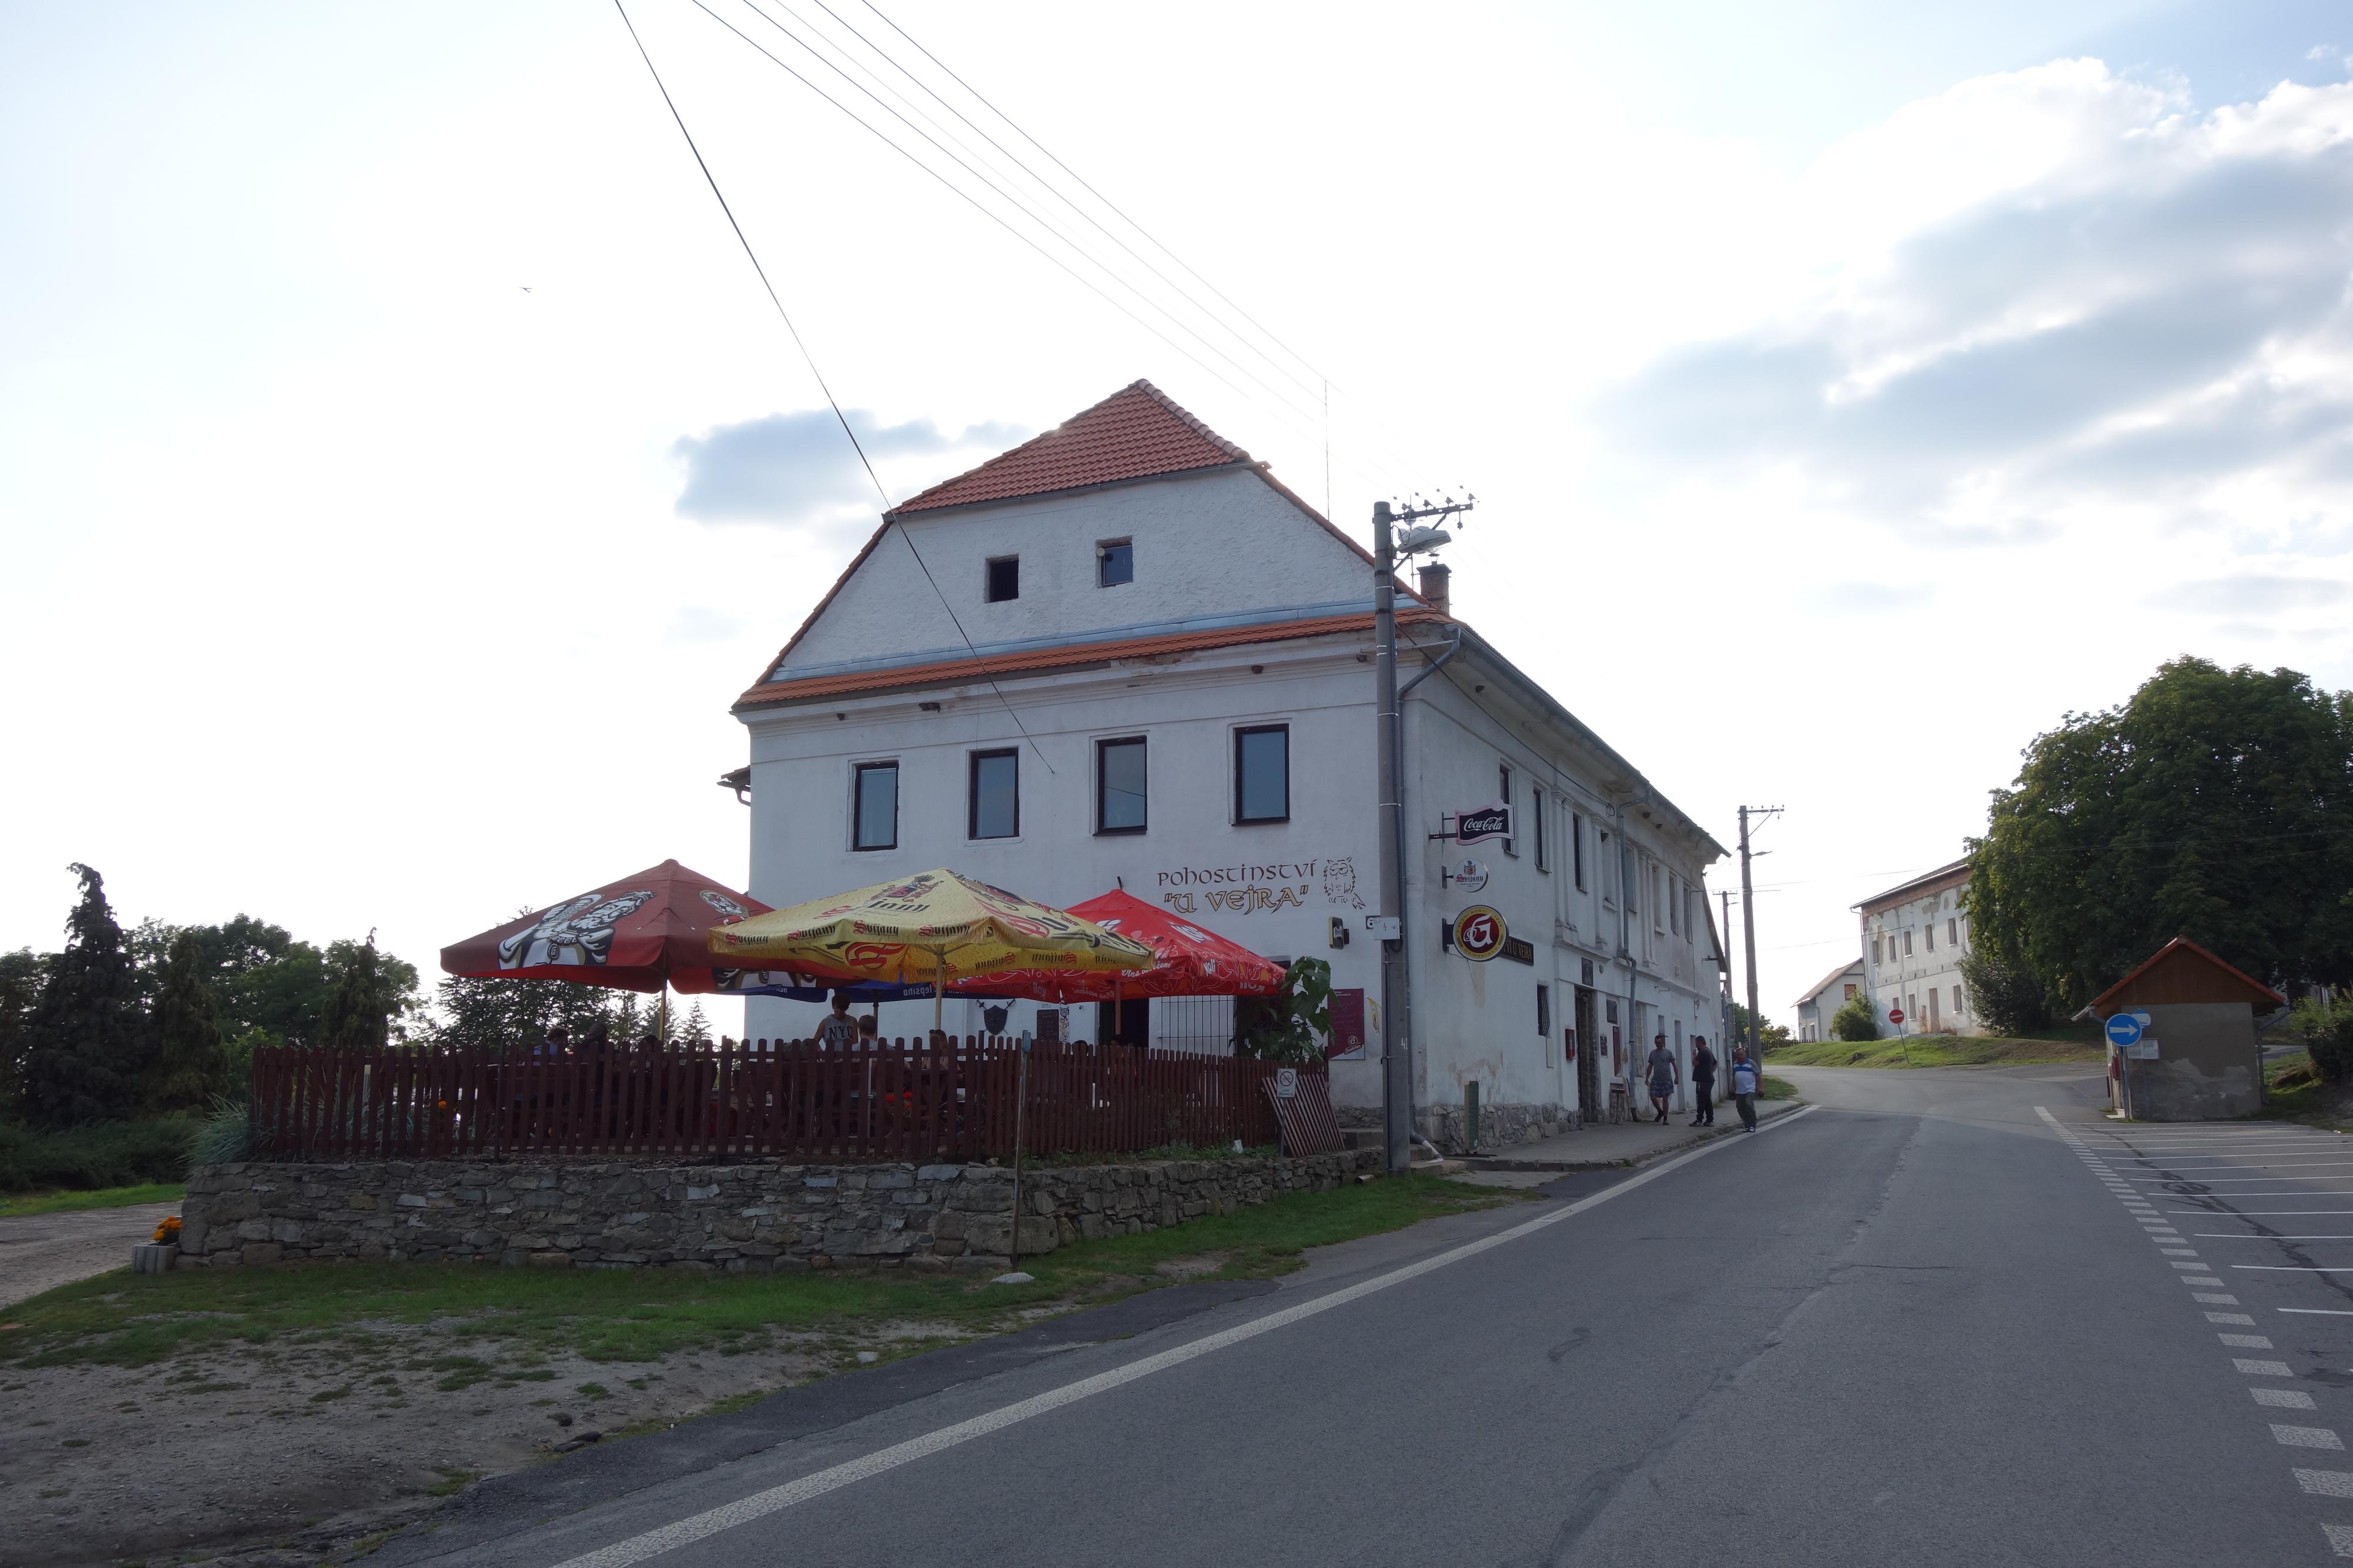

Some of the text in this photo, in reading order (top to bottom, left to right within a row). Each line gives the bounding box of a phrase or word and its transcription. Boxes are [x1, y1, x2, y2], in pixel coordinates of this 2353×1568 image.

[1464, 816, 1505, 832] Coca-Cola
[1456, 874, 1484, 883] Svijany
[787, 925, 836, 941] Svijany
[854, 919, 899, 936] Svijany
[919, 924, 971, 936] Svijany
[725, 933, 768, 945] Svijany
